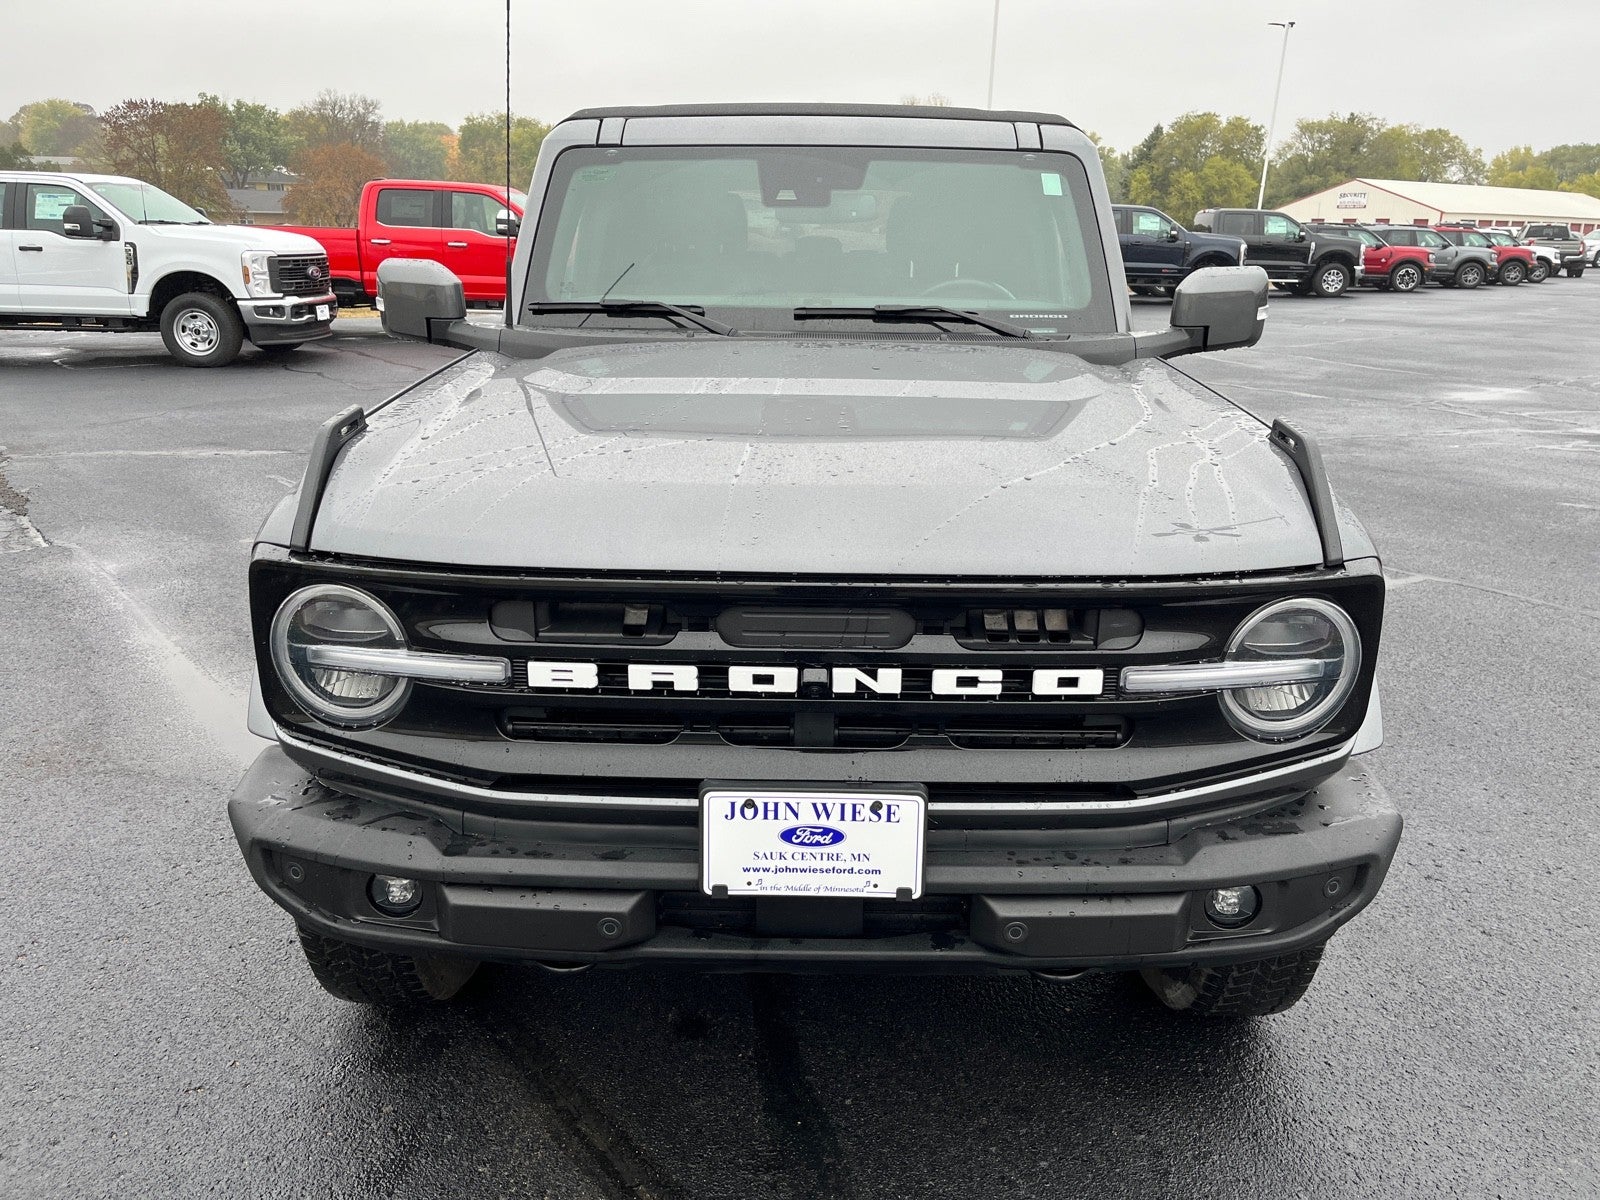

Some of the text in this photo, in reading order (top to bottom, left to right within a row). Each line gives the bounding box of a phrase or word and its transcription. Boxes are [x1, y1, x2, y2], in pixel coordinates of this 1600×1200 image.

[527, 661, 1104, 696] BRONCO
[725, 801, 900, 823] JOHN WIESE
[791, 827, 834, 845] Ford
[753, 851, 871, 863] SAUK CENTRE, MN
[742, 864, 882, 876] www.johnwieseford.com
[770, 884, 782, 892] the
[783, 884, 812, 892] Middle
[813, 885, 822, 895] of
[823, 885, 865, 893] Minnesota
